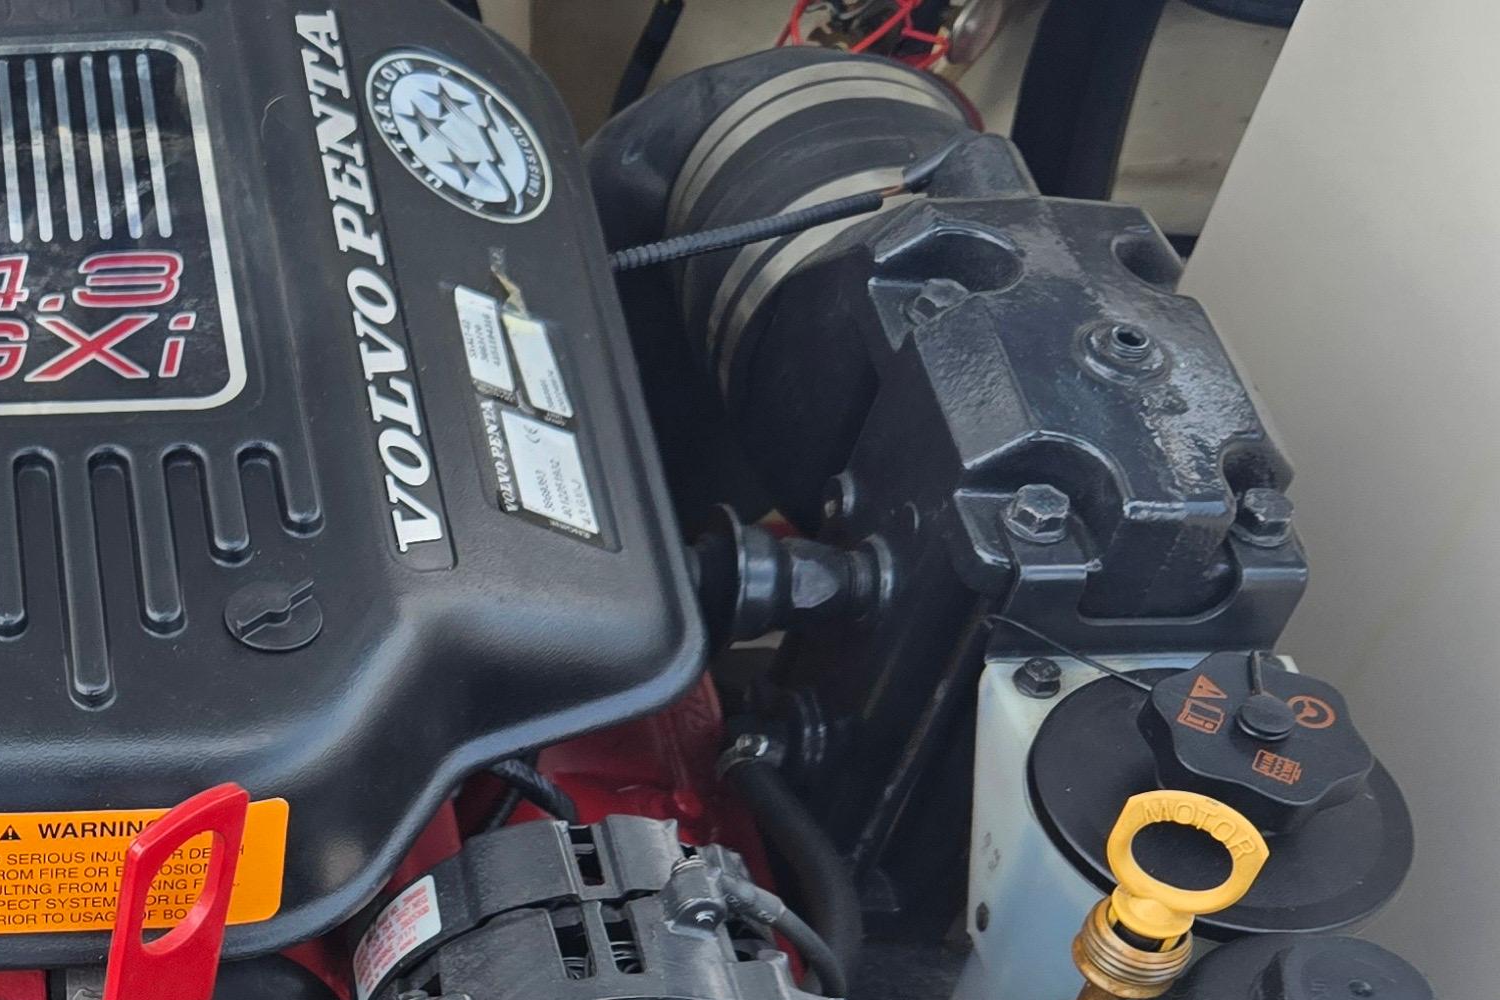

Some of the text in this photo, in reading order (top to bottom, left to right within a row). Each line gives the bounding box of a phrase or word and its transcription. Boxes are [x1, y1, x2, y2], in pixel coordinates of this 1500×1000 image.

[295, 9, 443, 553] VOLVO PENTA
[38, 819, 158, 840] WARNIN
[1142, 800, 1257, 861] MOTOR
[6, 851, 85, 866] SERIOUS
[90, 851, 125, 863] INJU
[39, 867, 79, 879] FIRE
[83, 866, 109, 878] OR
[58, 881, 108, 894] FROM
[42, 912, 64, 924] TO
[69, 911, 116, 923] USAG
